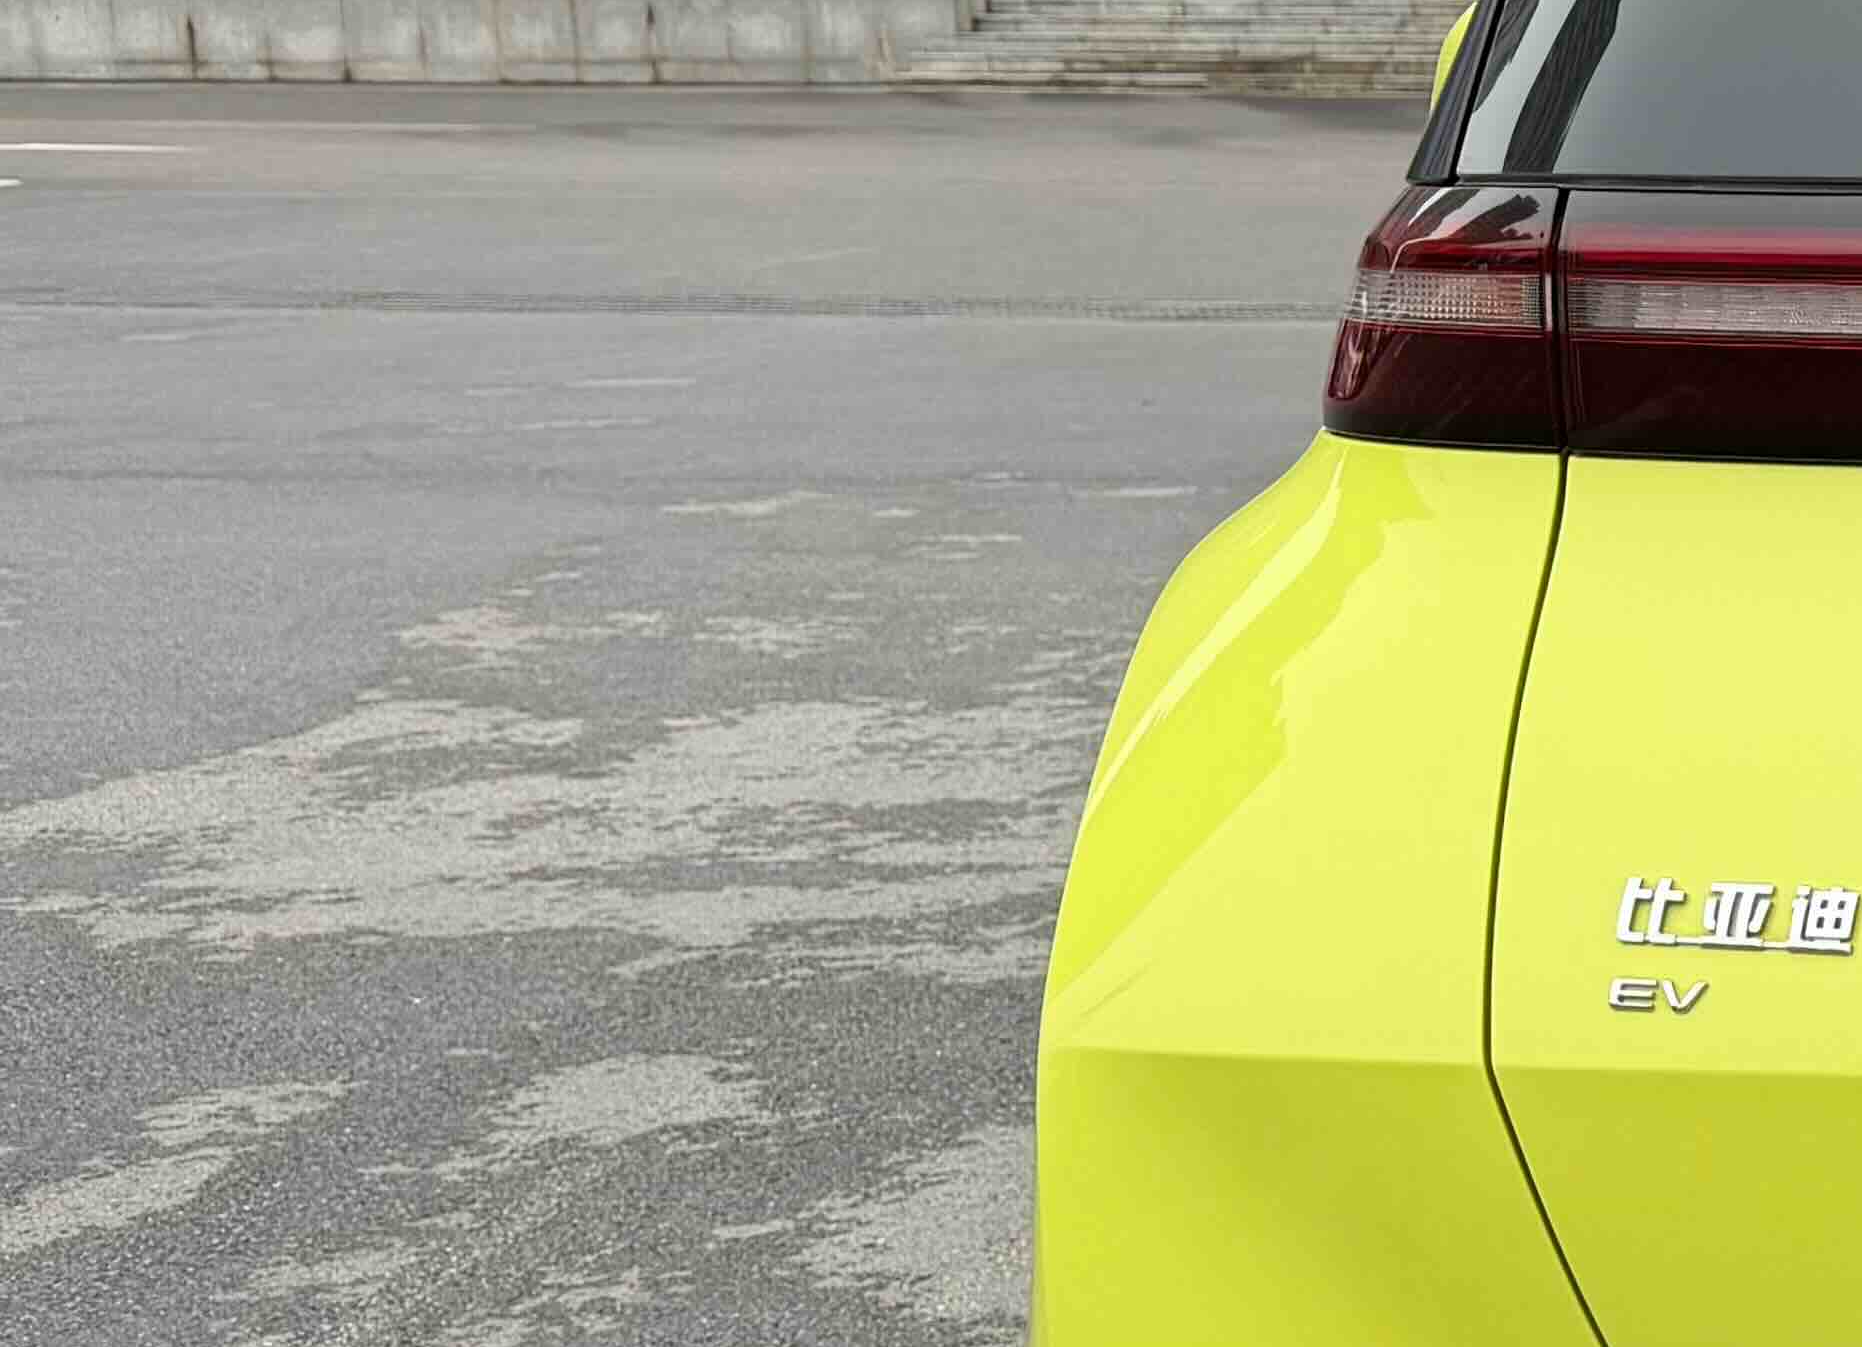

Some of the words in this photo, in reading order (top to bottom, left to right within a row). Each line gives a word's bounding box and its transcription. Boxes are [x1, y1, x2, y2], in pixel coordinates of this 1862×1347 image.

[1616, 877, 1861, 955] 比亚迪
[1608, 978, 1710, 1014] EV
